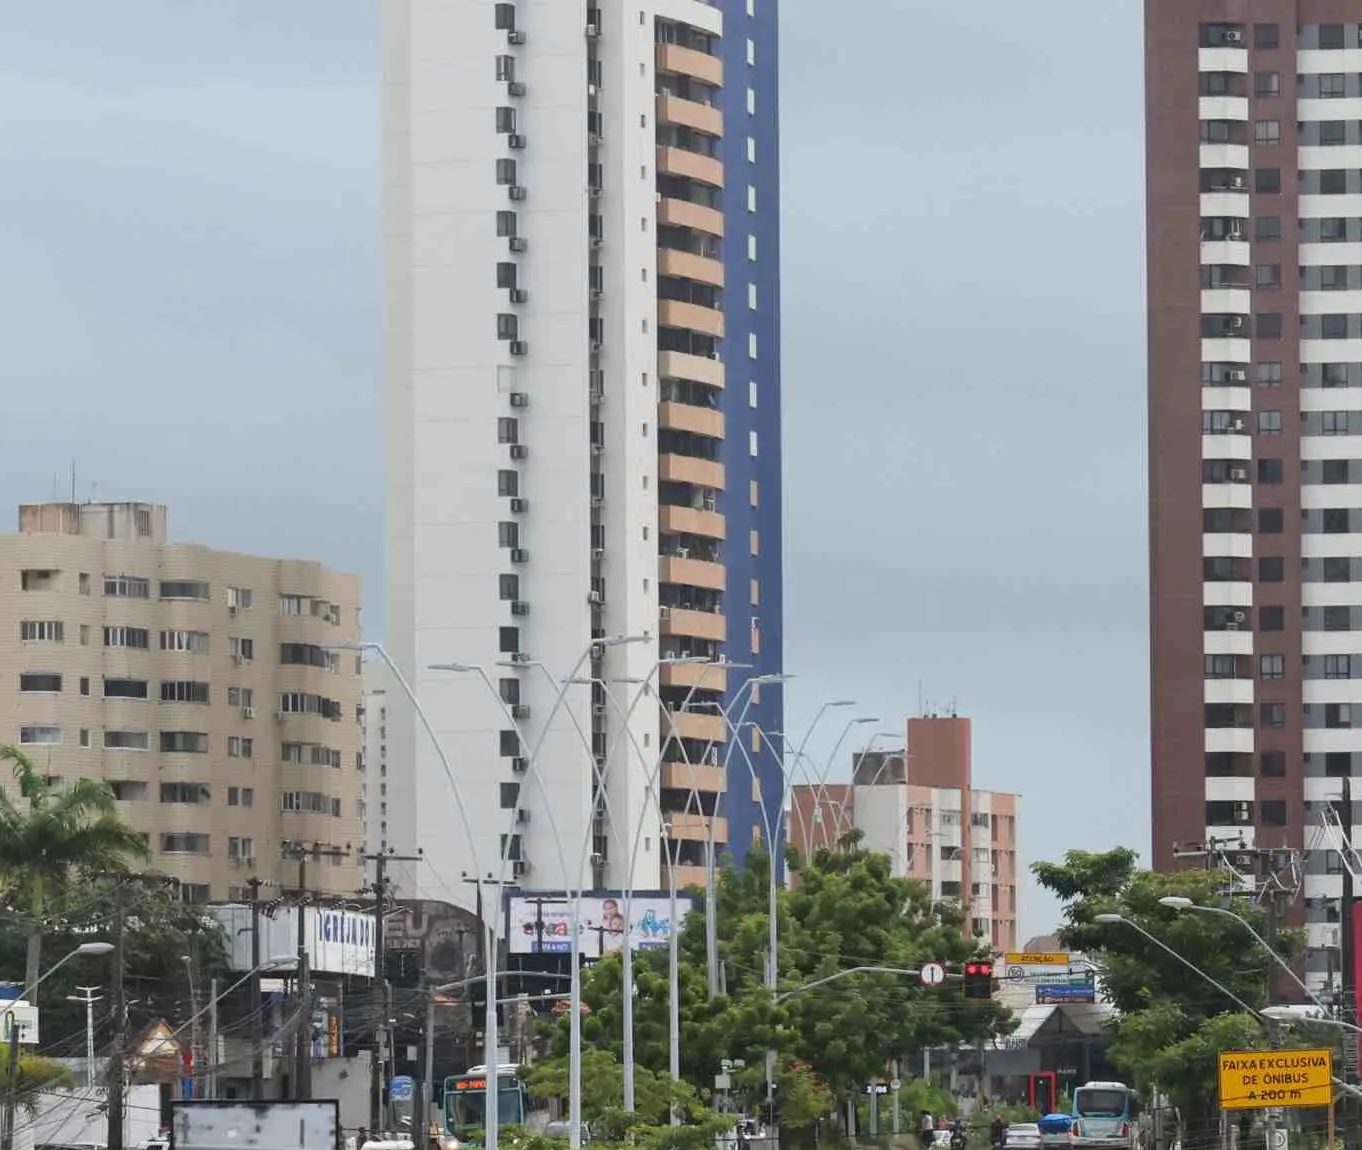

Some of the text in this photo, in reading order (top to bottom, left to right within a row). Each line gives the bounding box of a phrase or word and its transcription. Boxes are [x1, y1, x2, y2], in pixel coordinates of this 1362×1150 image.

[319, 911, 357, 945] IGREJA
[1222, 1056, 1327, 1071] FAIXA EXCLUSIVA
[1242, 1071, 1310, 1086] DE ÔNIBUS
[1247, 1090, 1257, 1101] A
[1260, 1089, 1286, 1100] 200
